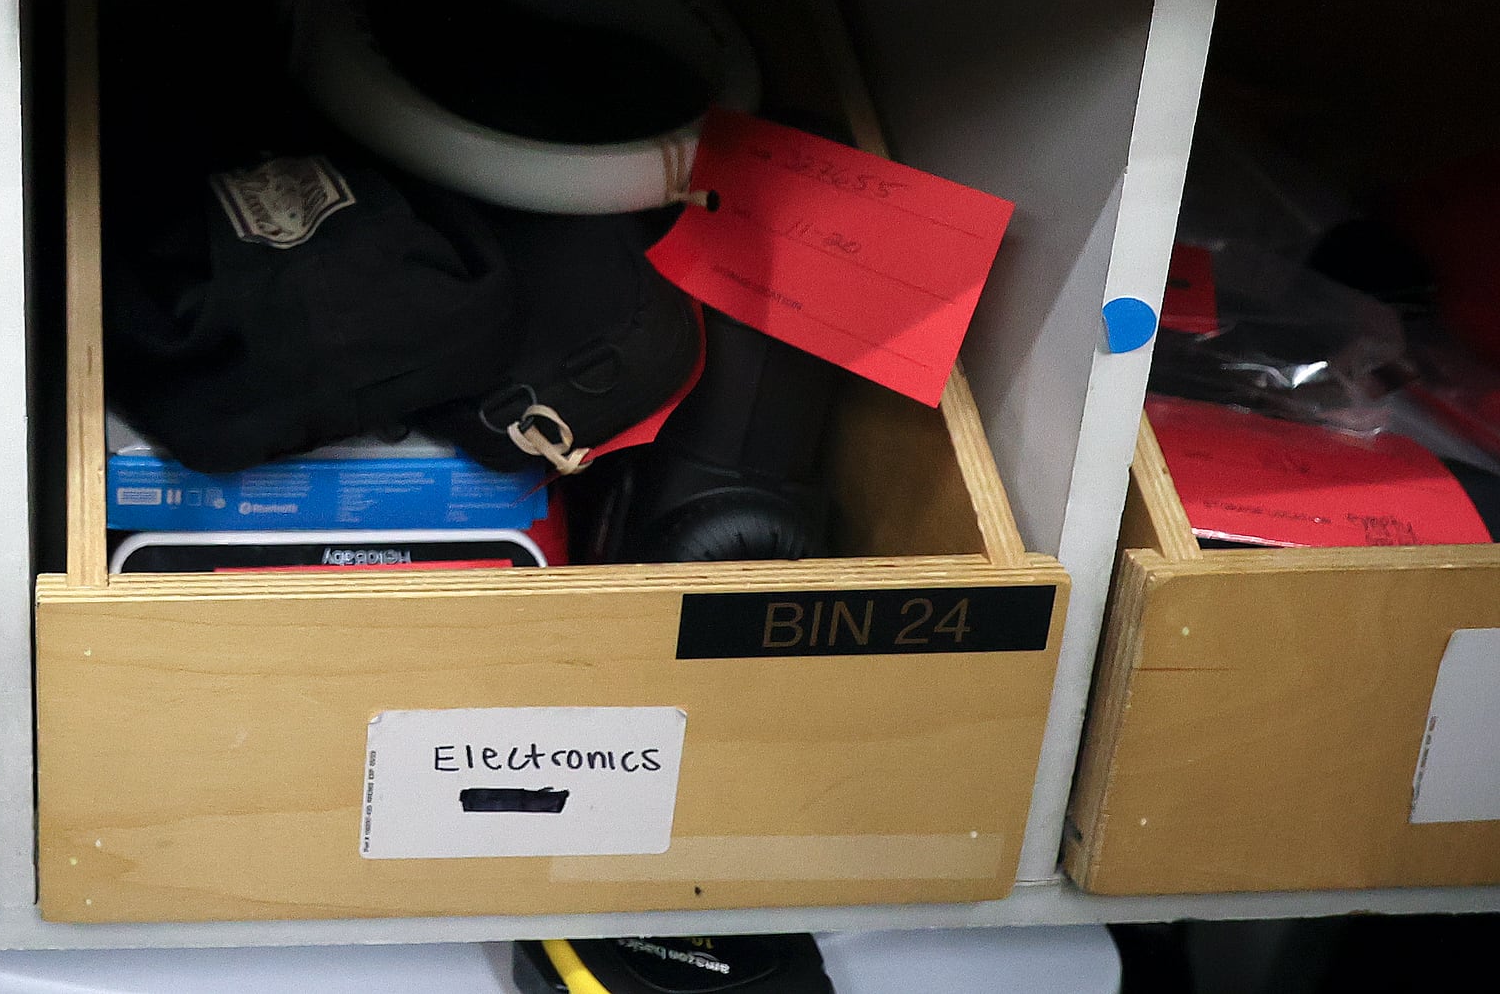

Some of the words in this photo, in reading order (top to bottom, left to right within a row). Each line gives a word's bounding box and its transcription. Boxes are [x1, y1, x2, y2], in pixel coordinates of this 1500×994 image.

[762, 600, 874, 648] BIN
[894, 597, 972, 645] 24
[434, 743, 661, 773] Electronics
